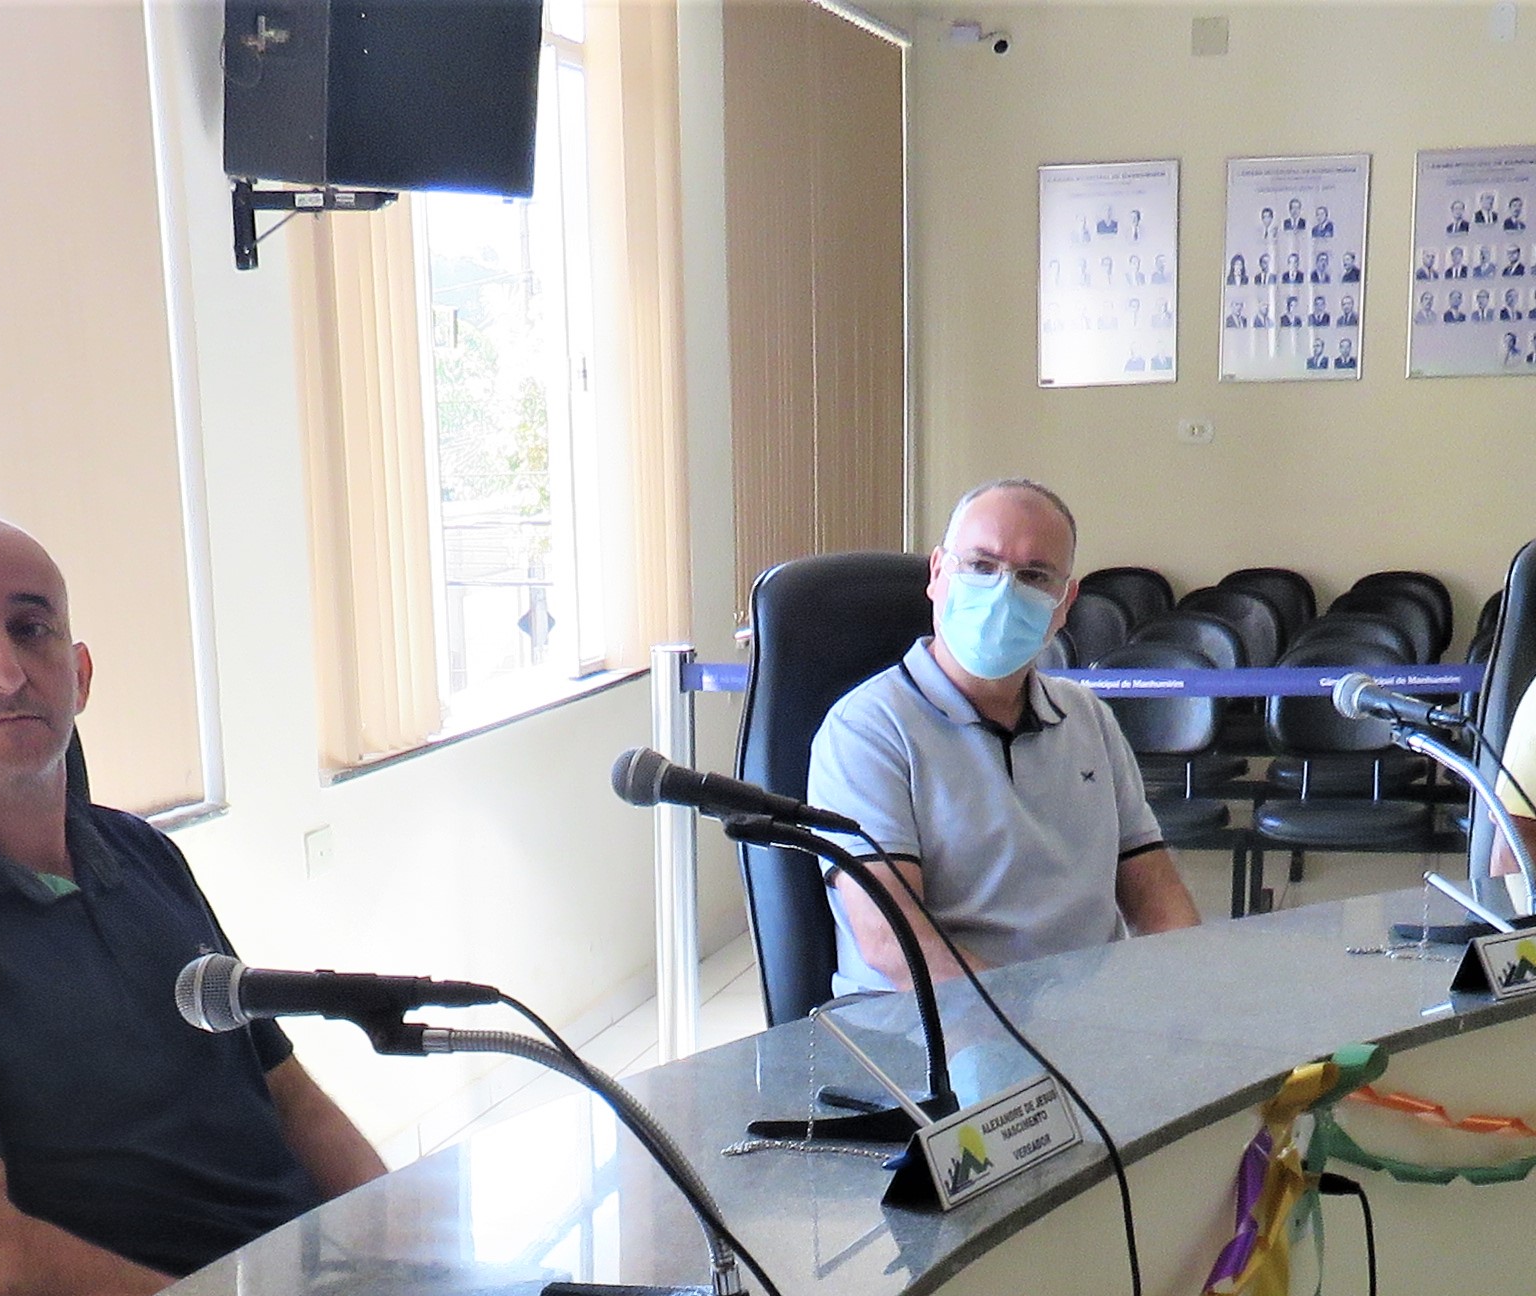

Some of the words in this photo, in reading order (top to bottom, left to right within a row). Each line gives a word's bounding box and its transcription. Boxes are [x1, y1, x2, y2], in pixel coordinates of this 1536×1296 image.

[981, 1105, 1025, 1136] ALEXANDRE
[1024, 1099, 1036, 1116] DE
[1001, 1110, 1048, 1141] NASCIMENTO
[1012, 1133, 1051, 1161] VEREADOR
